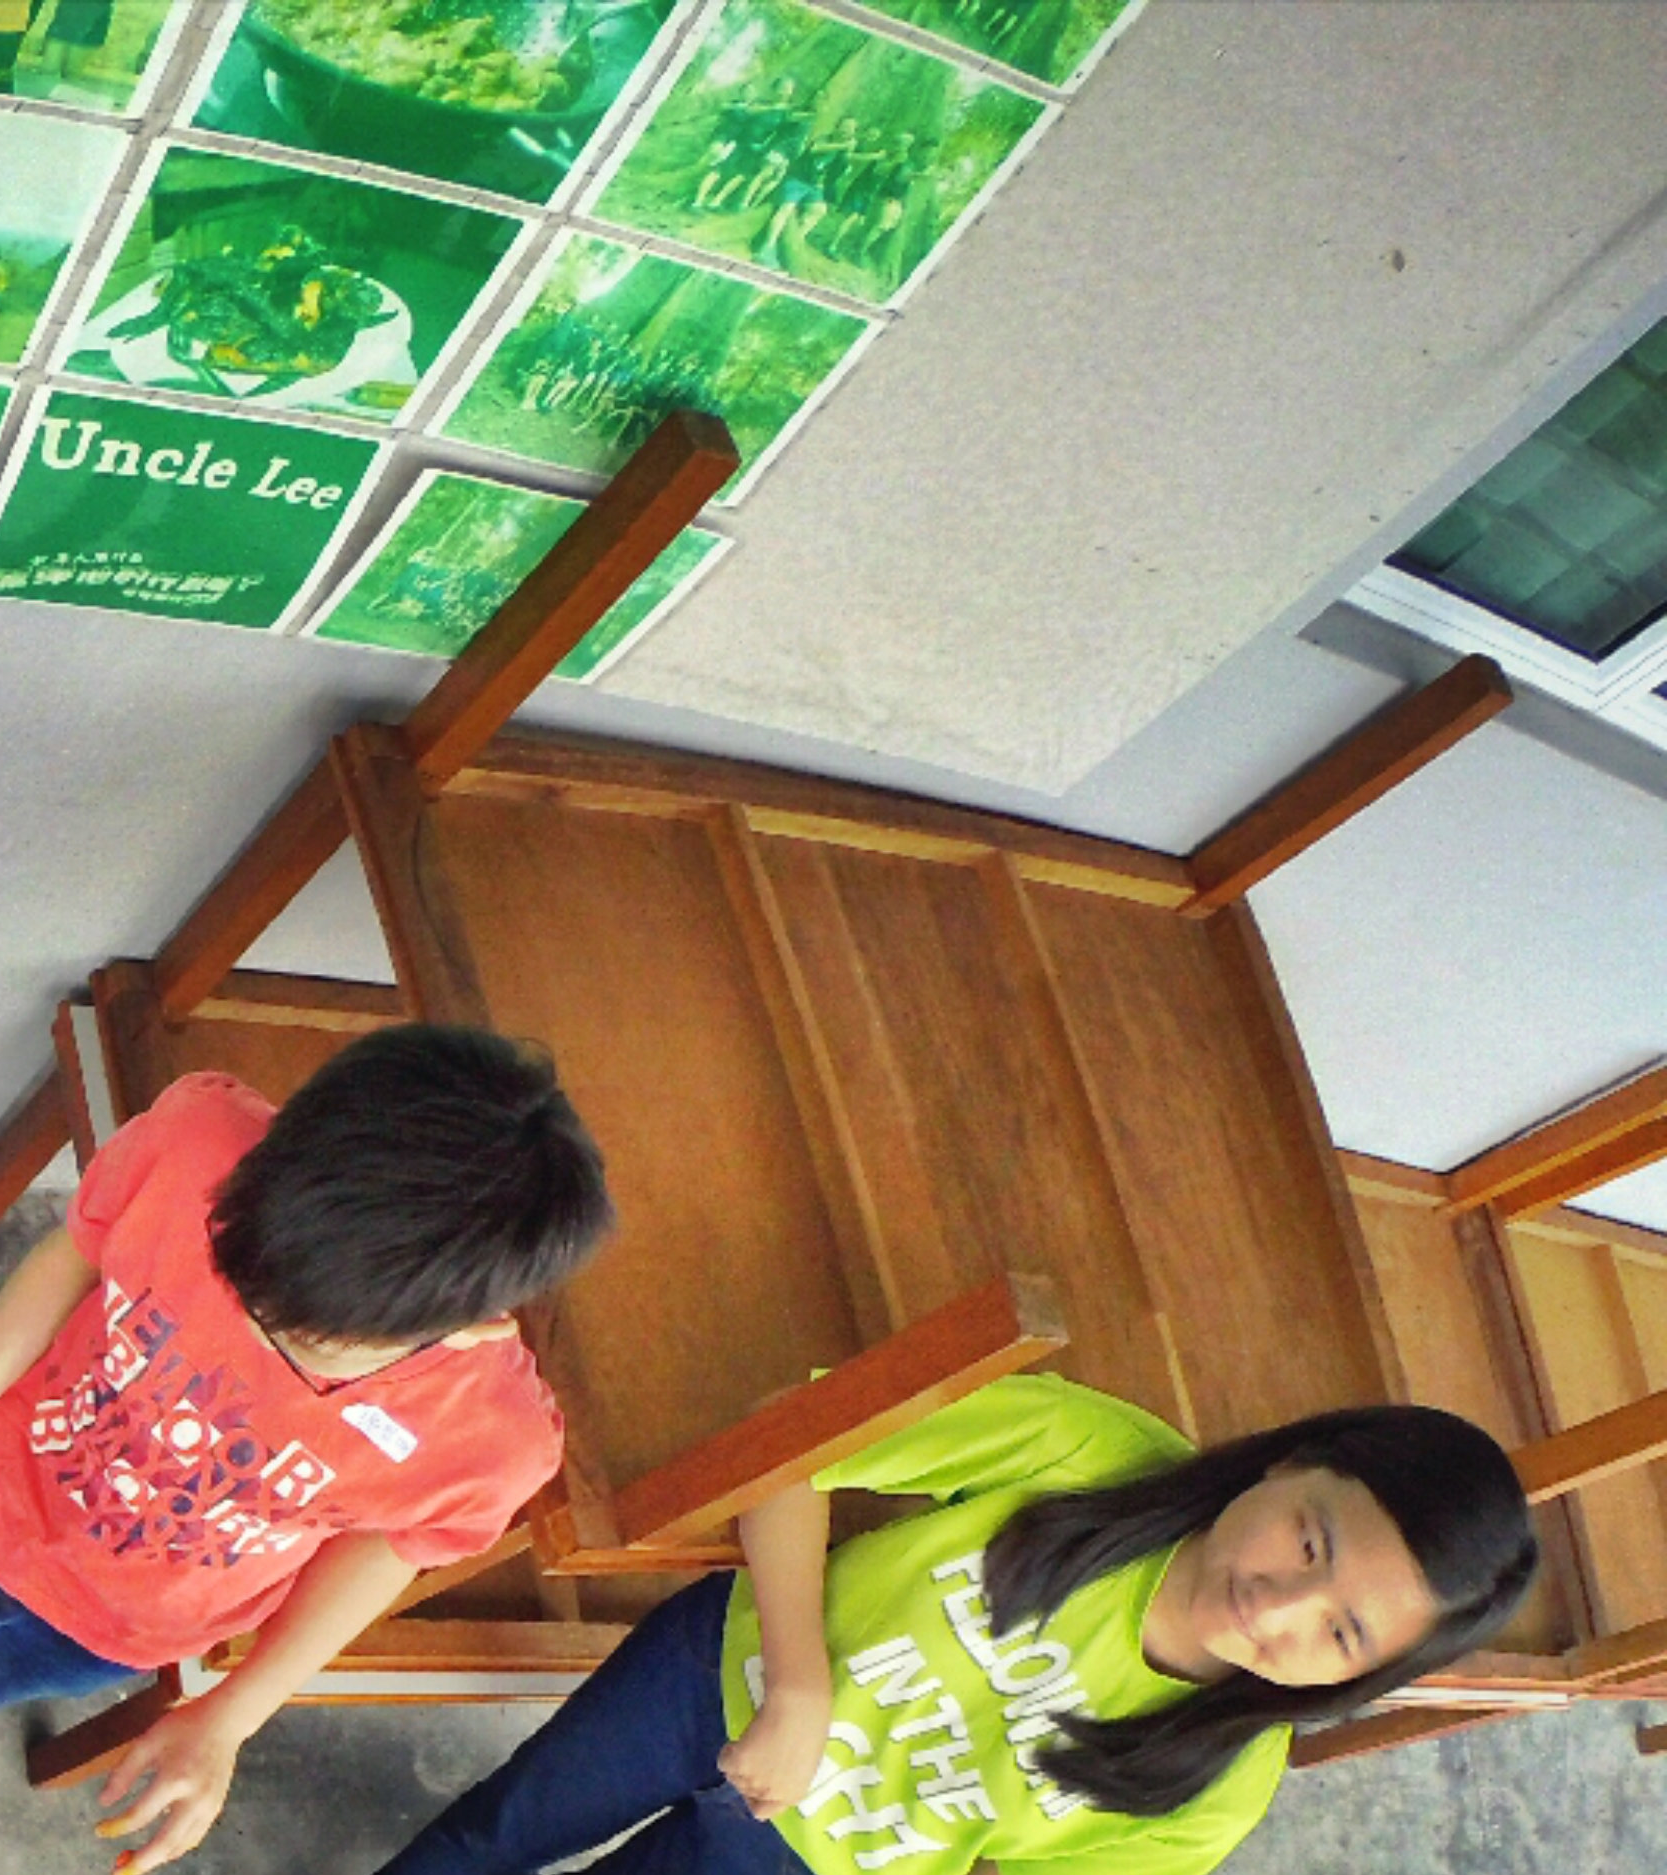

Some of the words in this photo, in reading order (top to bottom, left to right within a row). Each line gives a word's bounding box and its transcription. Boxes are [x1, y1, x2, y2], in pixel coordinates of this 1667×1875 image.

[41, 417, 238, 489] Uncle
[247, 455, 344, 510] Lee
[847, 1635, 943, 1709] IN
[889, 1692, 999, 1825] THE
